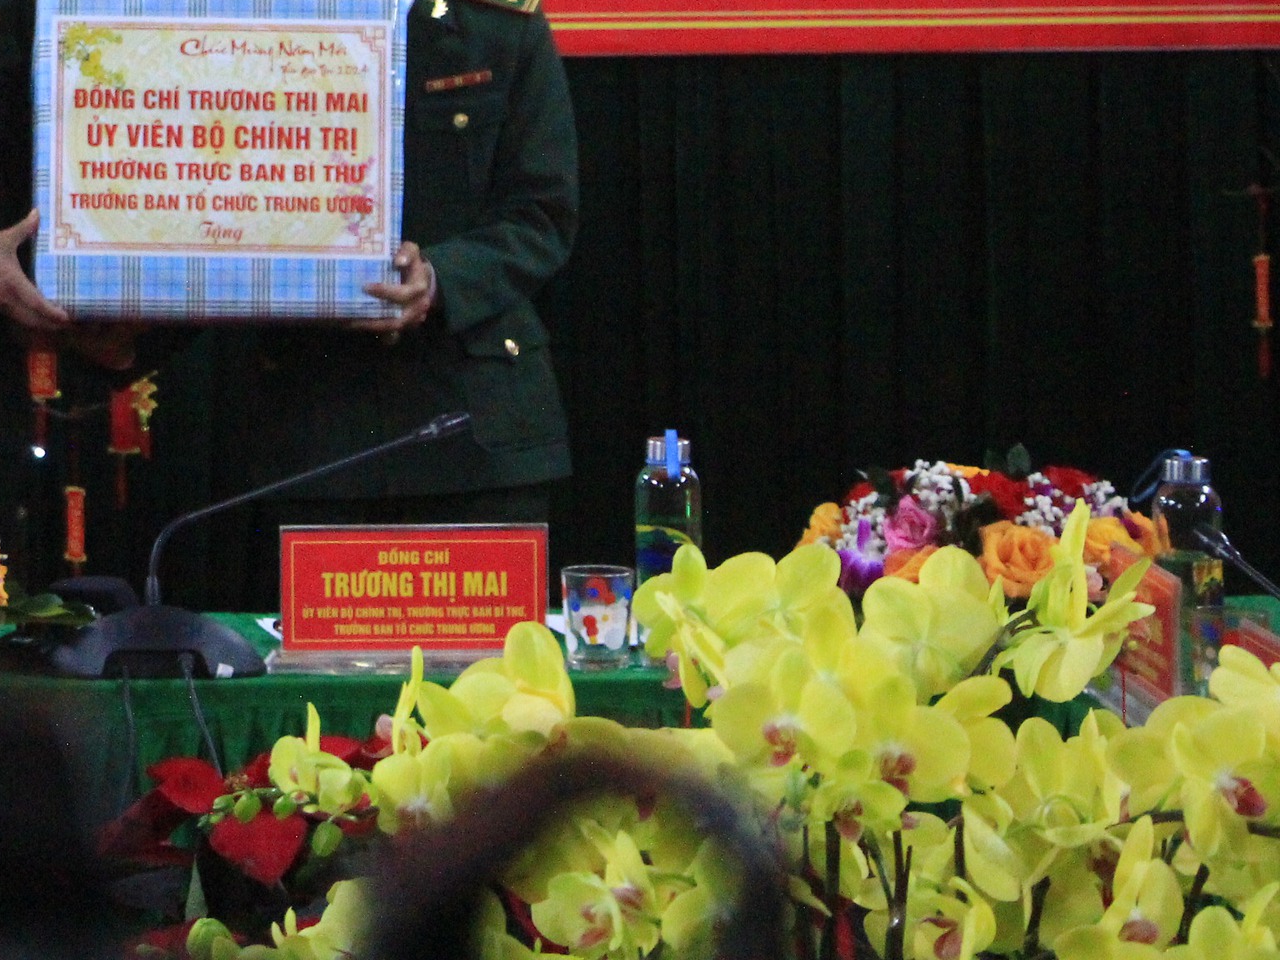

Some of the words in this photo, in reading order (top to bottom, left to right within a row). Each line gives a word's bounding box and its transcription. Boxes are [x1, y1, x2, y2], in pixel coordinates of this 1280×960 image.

[74, 82, 136, 110] ĐỒNG
[144, 86, 180, 110] CHÍ
[188, 86, 276, 112] TRƯƠNG
[284, 90, 318, 117] THỊ
[326, 90, 368, 113] MAI
[88, 115, 119, 147] ỦY
[127, 119, 184, 148] VIÊN
[192, 120, 225, 154] BỘ
[234, 120, 311, 150] CHÍNH
[320, 126, 358, 157] TRỊ
[79, 157, 168, 180] THƯỜNG
[175, 161, 232, 186] TRỰC
[240, 163, 286, 182] BAN
[294, 160, 316, 182] BÍ
[323, 163, 368, 184] THƯ
[144, 193, 180, 211] BAN
[264, 196, 321, 213] TRUNG
[326, 194, 374, 215] ƯƠNG
[424, 548, 450, 565] CHÍ
[321, 569, 414, 598] TRƯƠNG
[420, 570, 456, 603] THỊ
[463, 570, 508, 597] MAI
